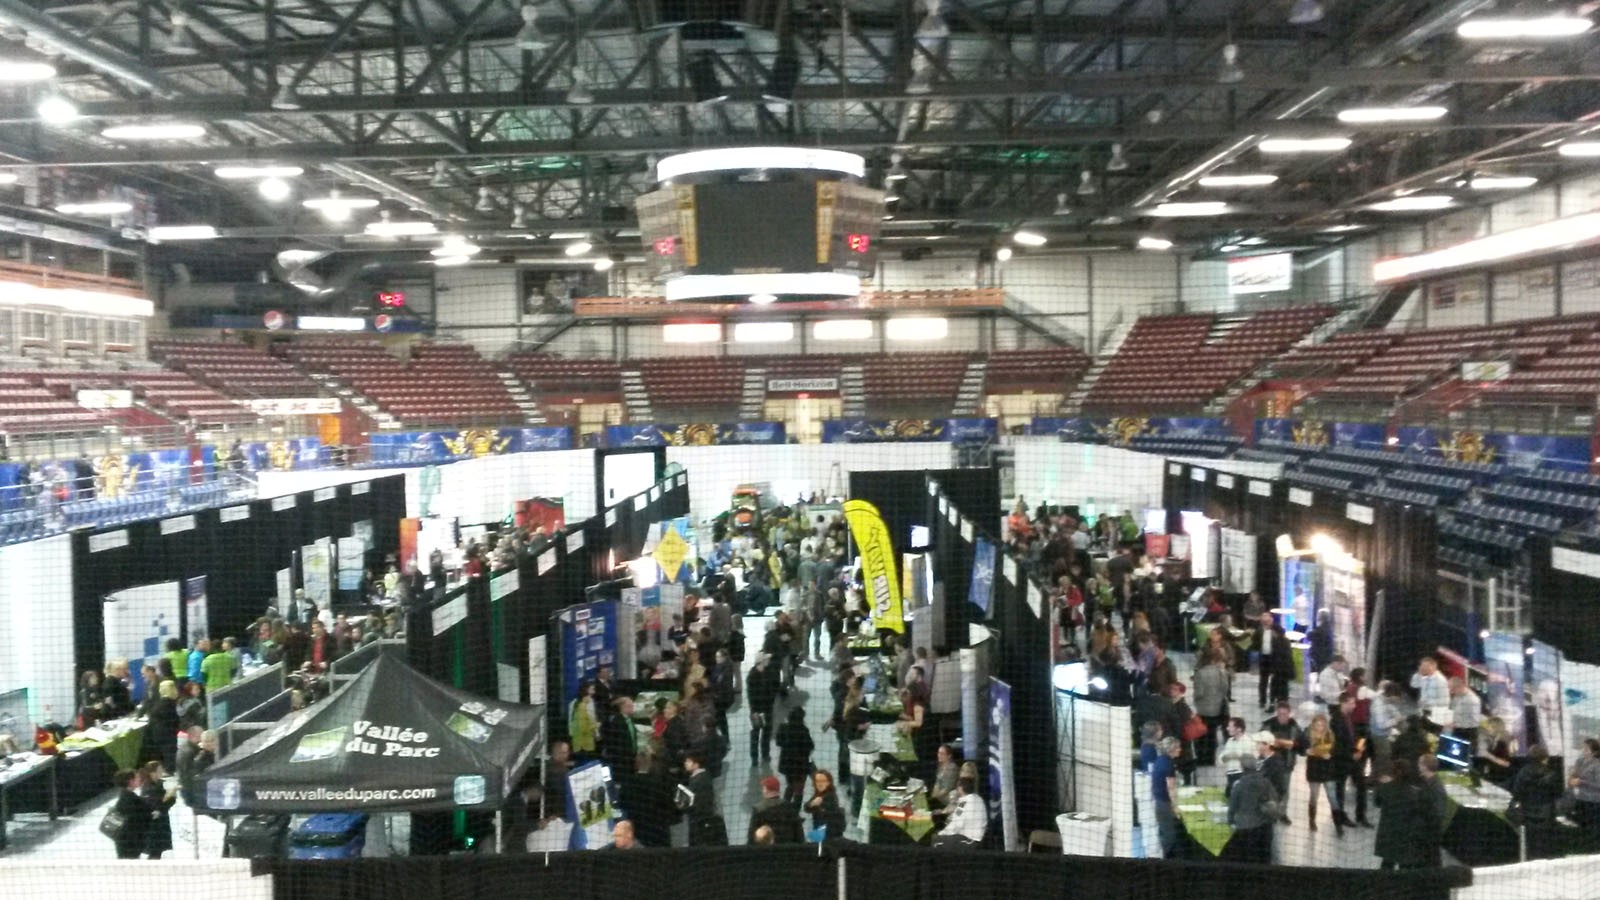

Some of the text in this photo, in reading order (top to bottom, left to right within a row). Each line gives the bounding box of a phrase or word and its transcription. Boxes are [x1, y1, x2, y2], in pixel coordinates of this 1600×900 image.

[353, 720, 429, 743] Vallée
[345, 737, 441, 758] du Parc
[255, 787, 437, 803] www.valleeduparc.com
